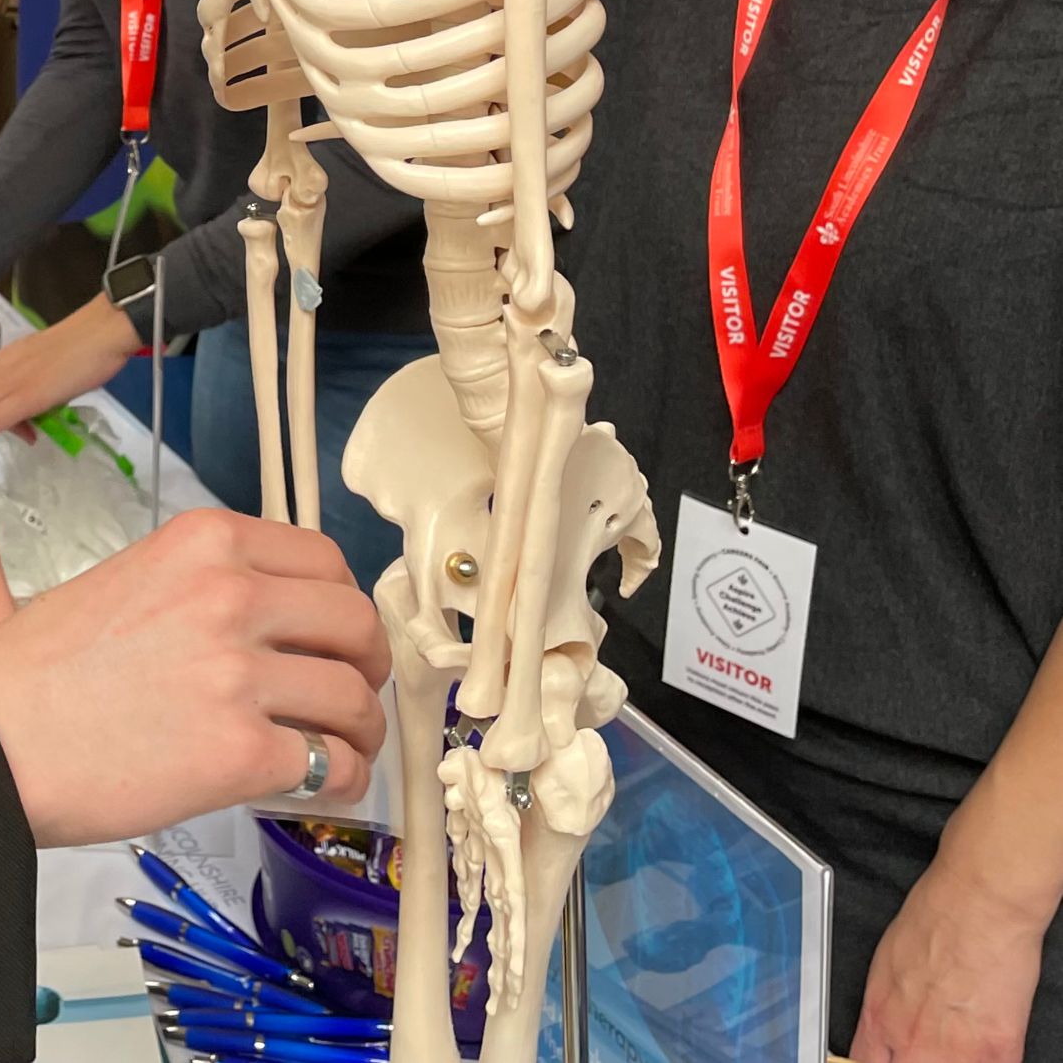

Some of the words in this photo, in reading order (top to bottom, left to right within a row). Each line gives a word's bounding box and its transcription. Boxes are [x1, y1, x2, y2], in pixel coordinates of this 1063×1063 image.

[898, 15, 942, 87] VISITOR
[720, 265, 746, 346] VISITOR
[769, 289, 812, 359] VISITOR
[696, 646, 773, 694] VISITOR
